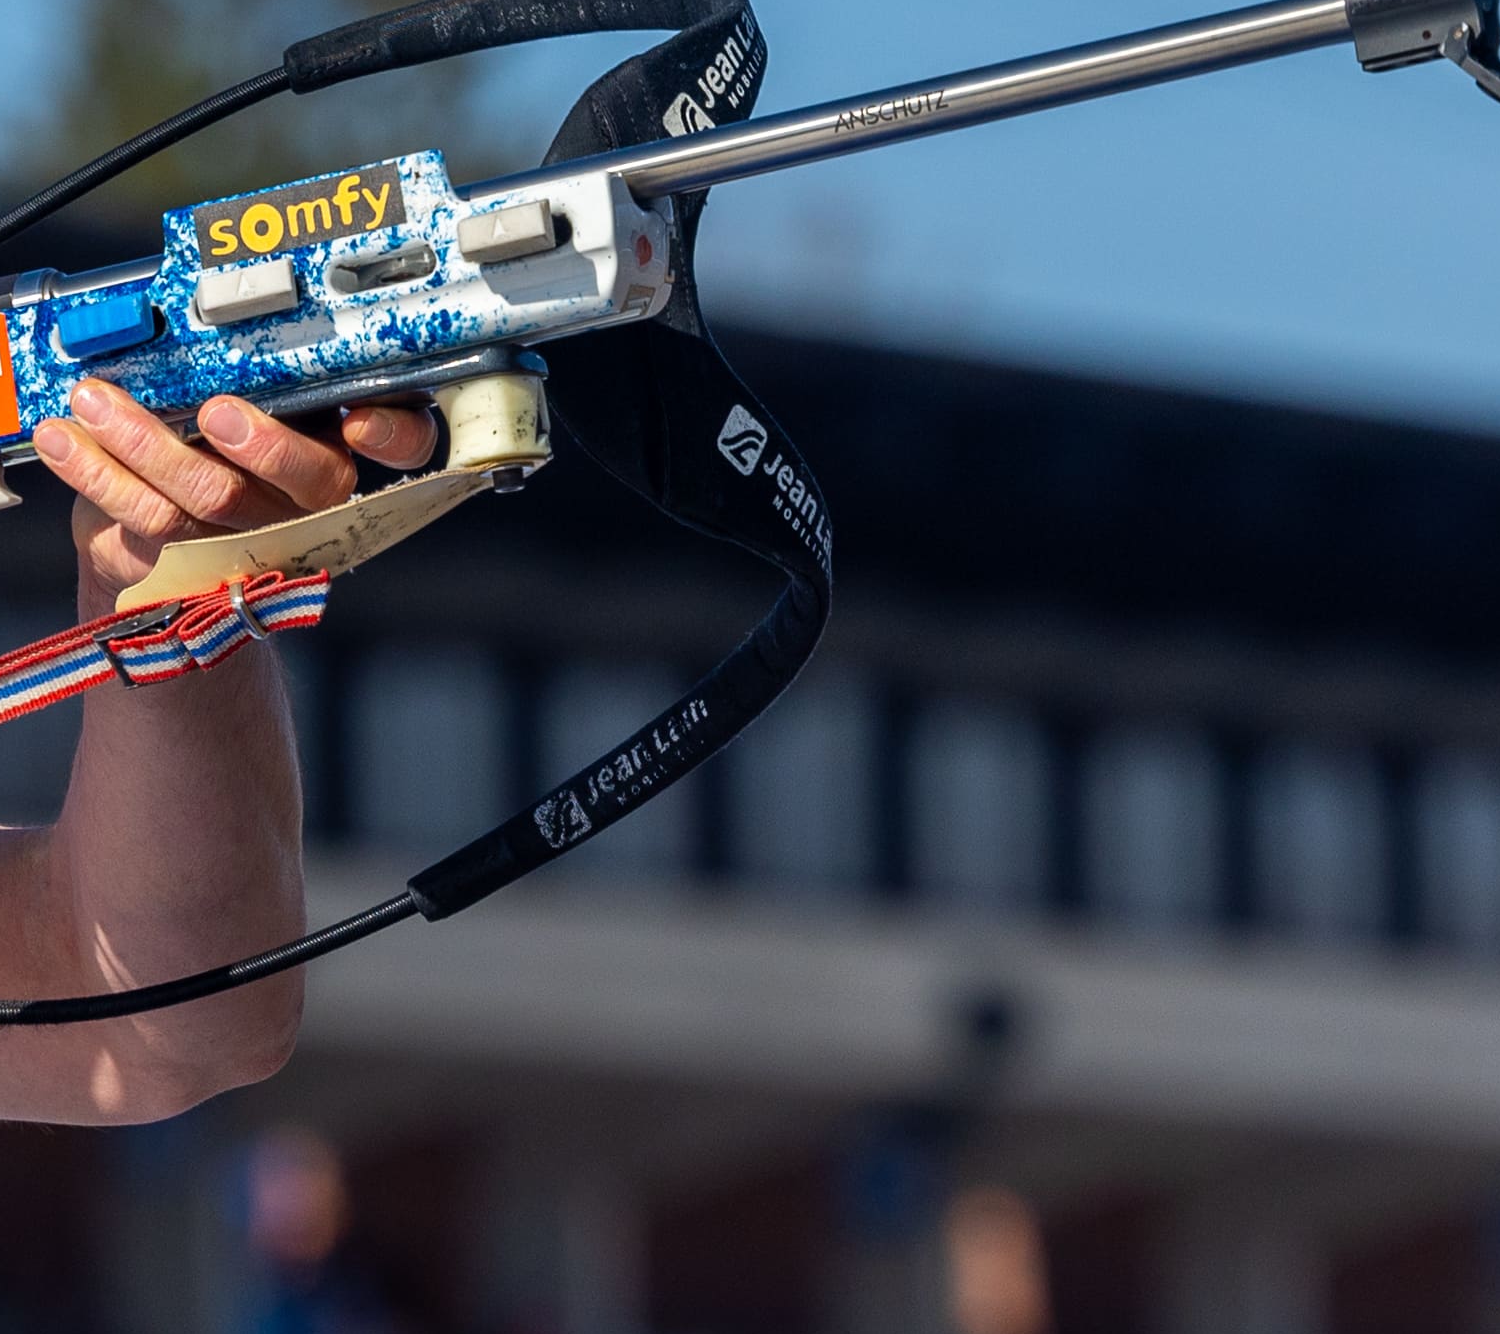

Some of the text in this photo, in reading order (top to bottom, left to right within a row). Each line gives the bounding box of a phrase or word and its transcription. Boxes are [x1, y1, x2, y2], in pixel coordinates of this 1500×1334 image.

[698, 36, 744, 107] Jean
[209, 175, 391, 256] somfy
[763, 453, 818, 525] Jean
